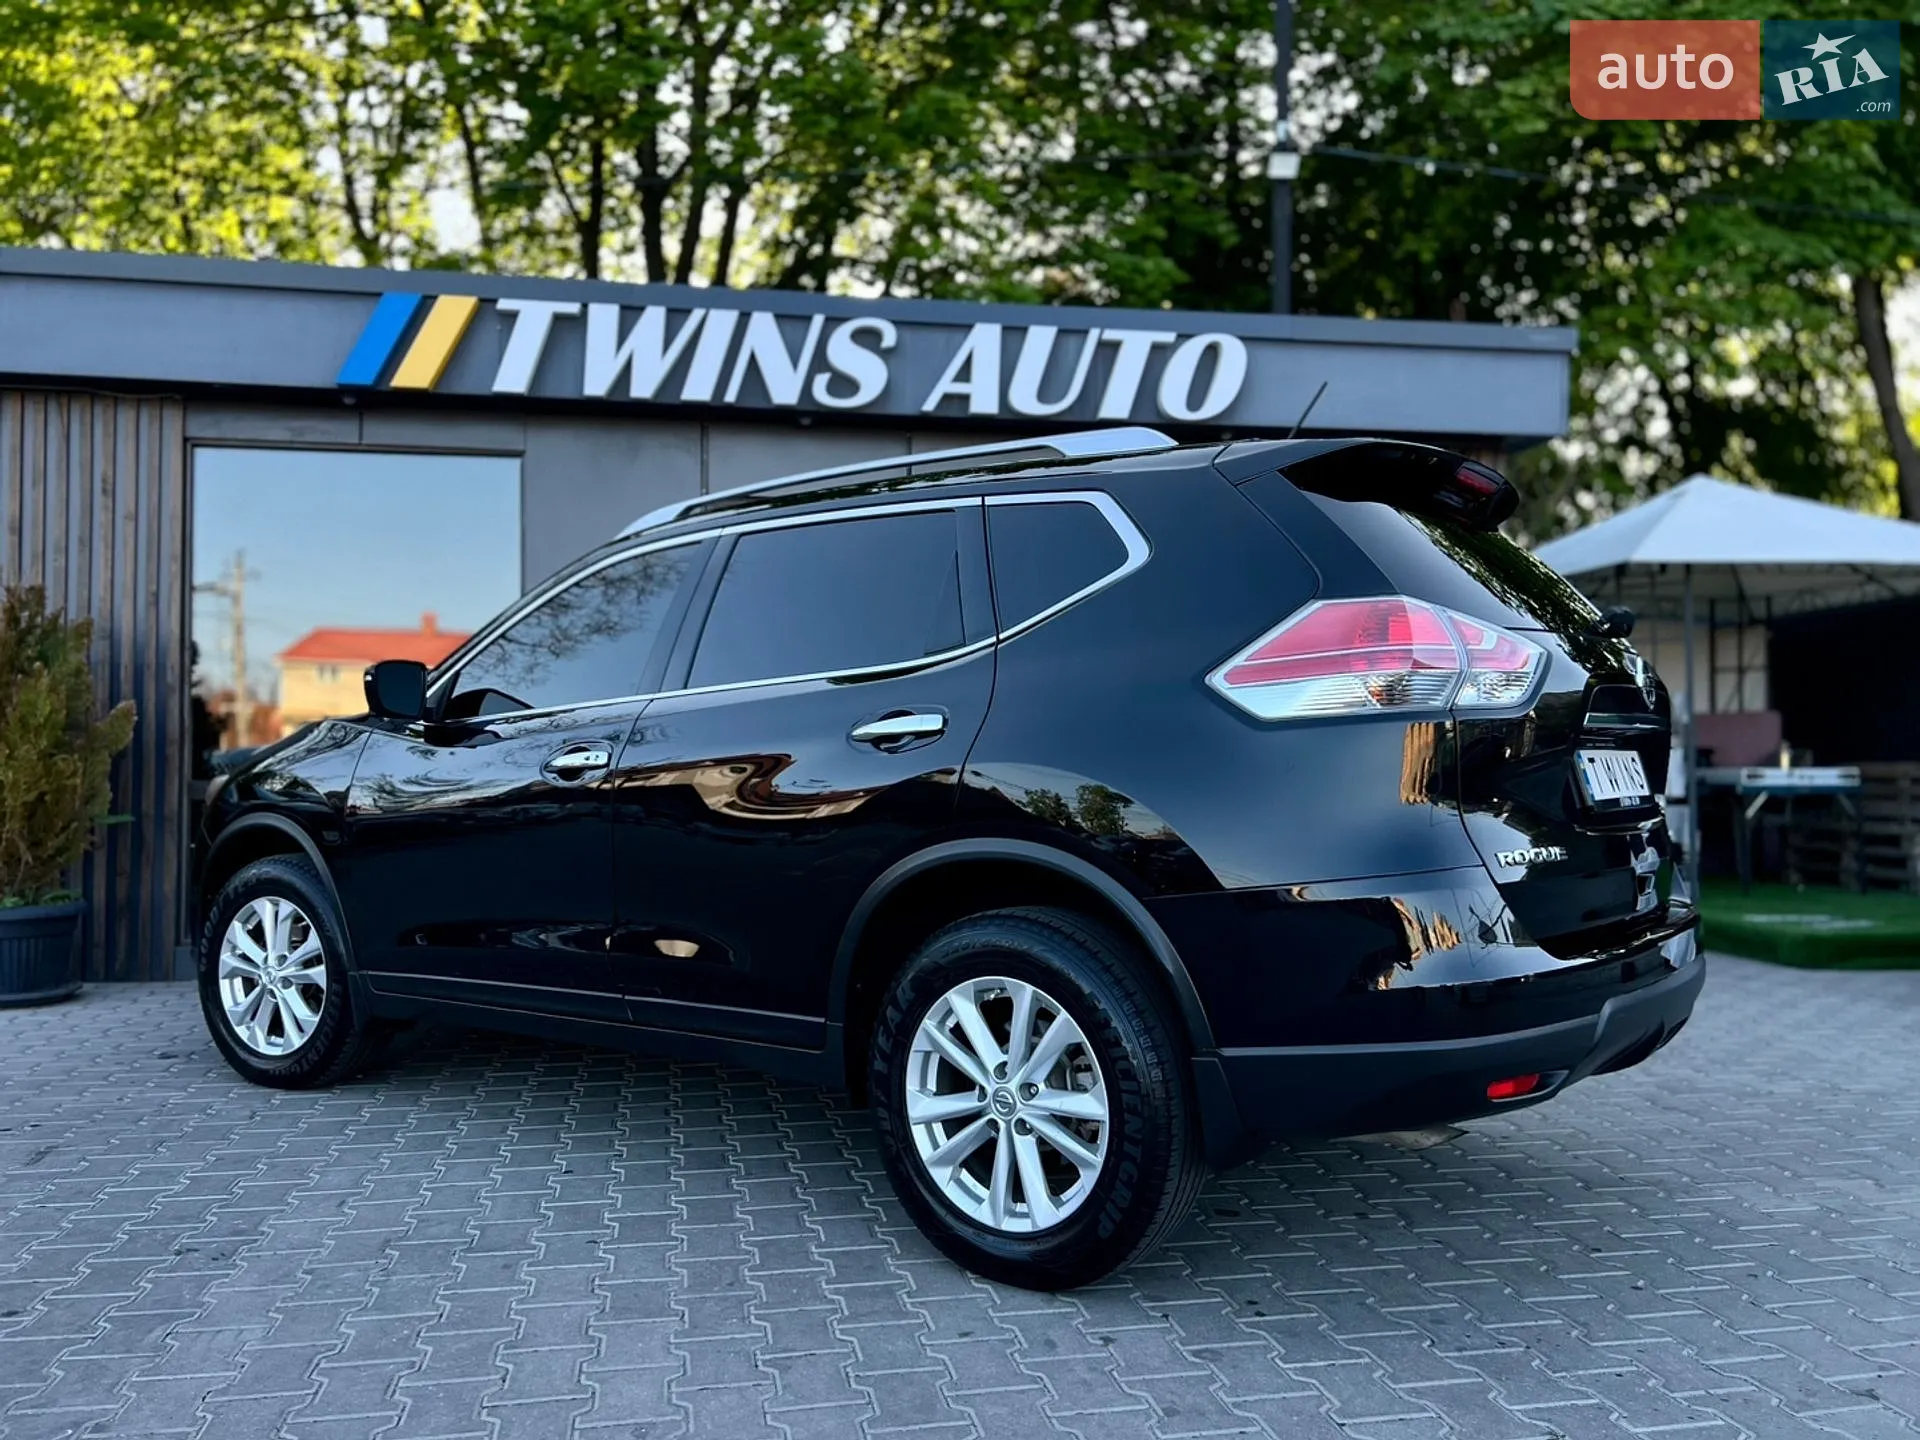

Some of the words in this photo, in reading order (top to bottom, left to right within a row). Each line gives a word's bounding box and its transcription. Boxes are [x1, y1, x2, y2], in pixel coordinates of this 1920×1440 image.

[492, 298, 897, 409] TWINS
[920, 322, 1248, 421] AUTO
[1587, 756, 1645, 794] TWINS
[1495, 846, 1568, 868] ROGUE
